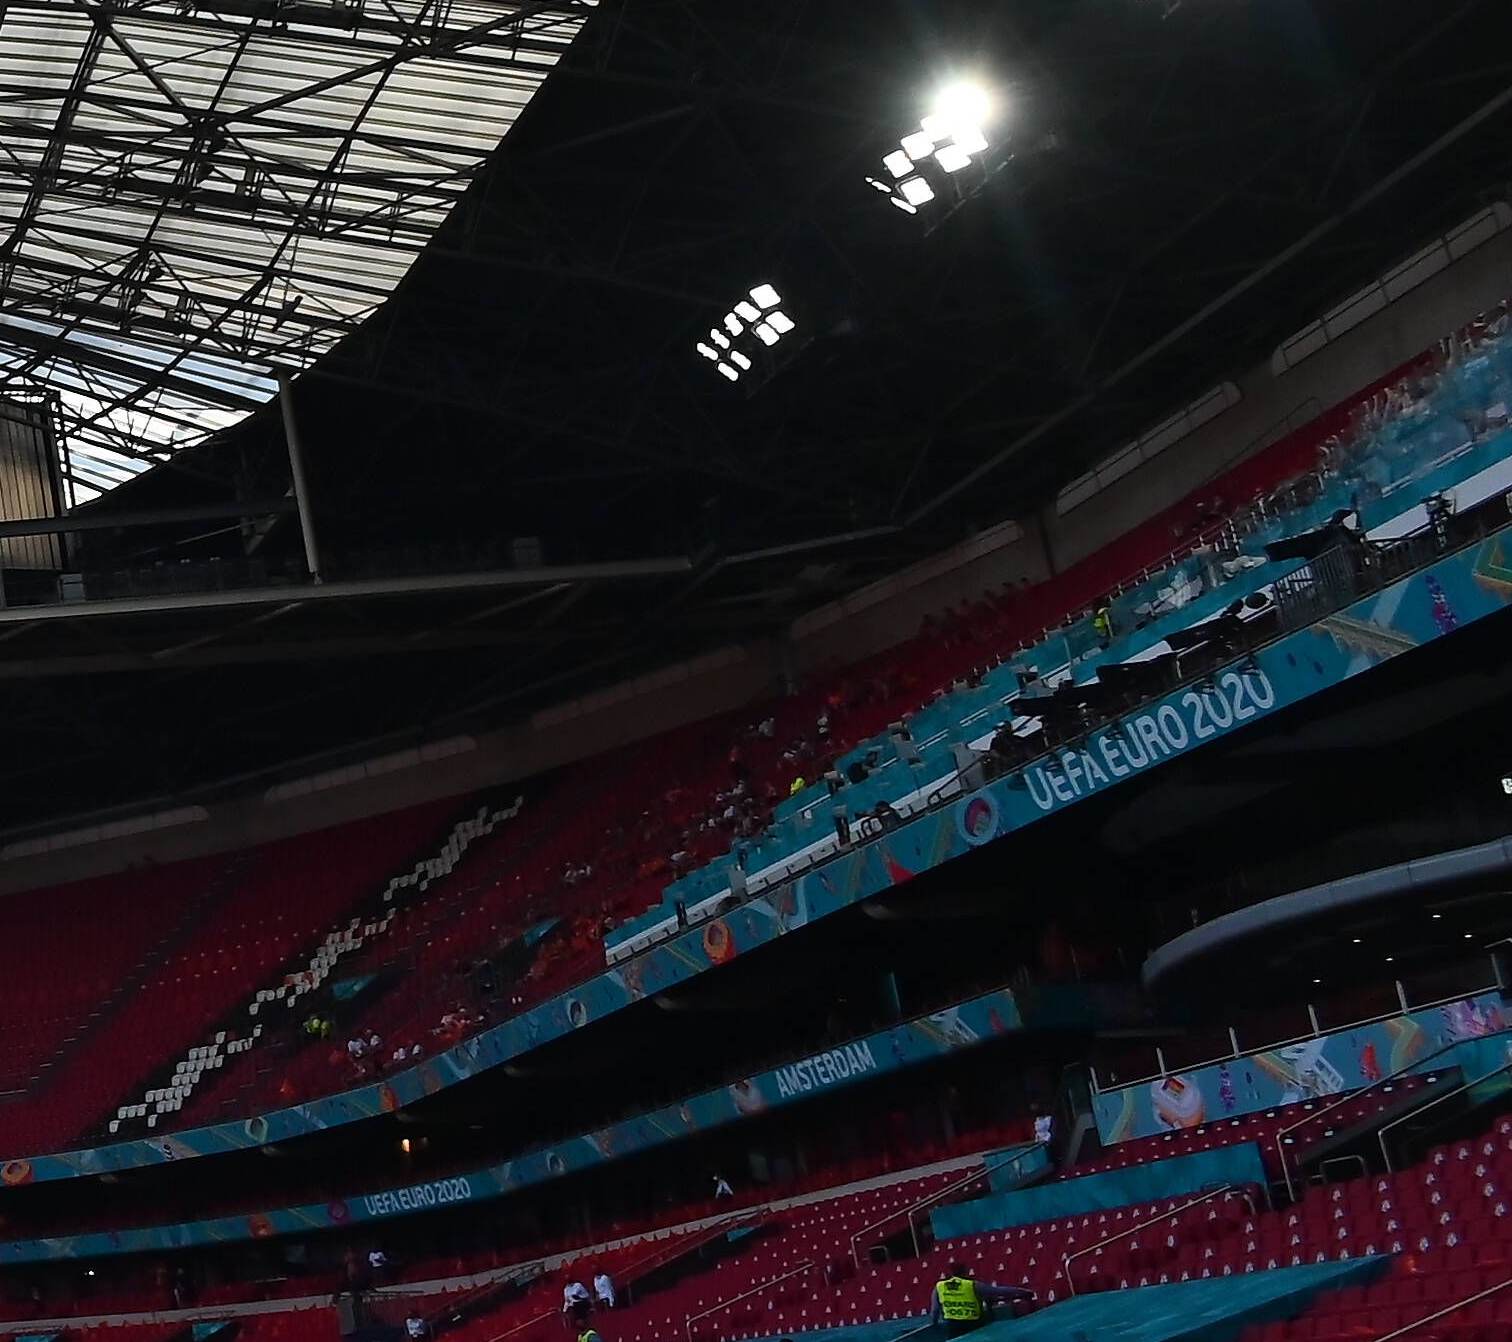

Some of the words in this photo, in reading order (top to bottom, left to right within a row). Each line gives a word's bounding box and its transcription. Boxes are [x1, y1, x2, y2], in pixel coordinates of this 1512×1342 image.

[1024, 751, 1110, 810] UEFA
[1098, 705, 1189, 777] EURO
[1181, 668, 1275, 740] 2020
[776, 1040, 877, 1098] AMSTERDAM
[365, 1192, 401, 1216] UEFA
[399, 1184, 436, 1210] EURO
[434, 1177, 471, 1202] 2020
